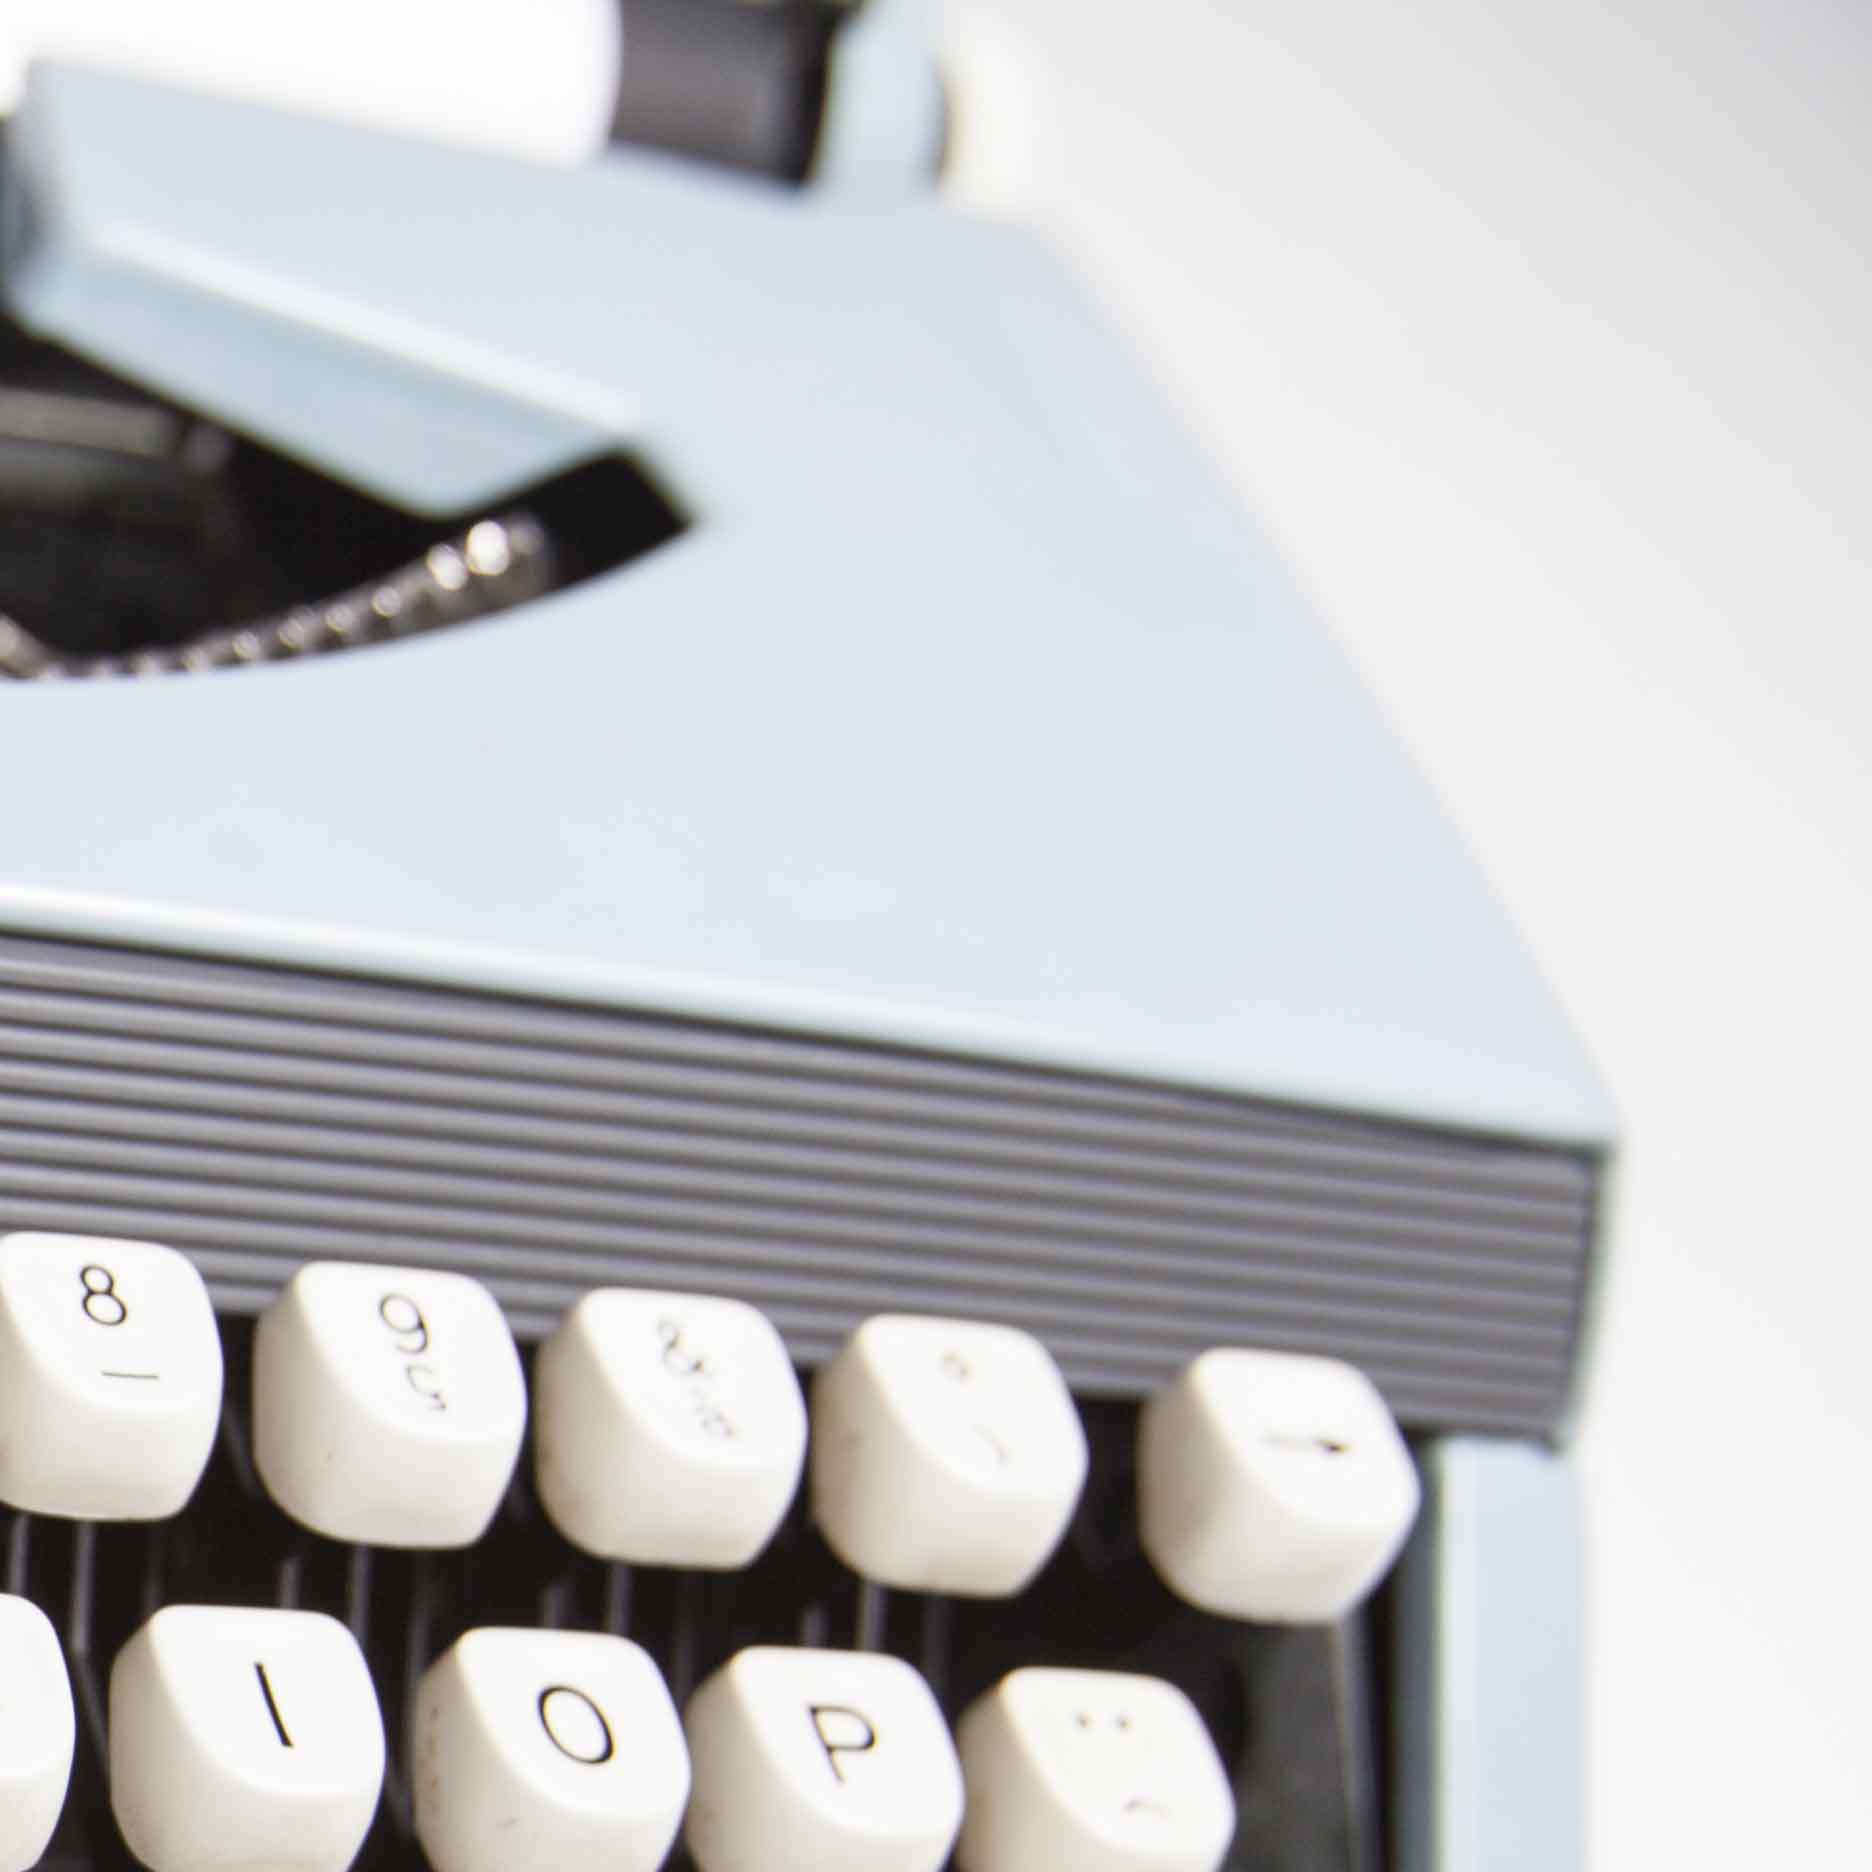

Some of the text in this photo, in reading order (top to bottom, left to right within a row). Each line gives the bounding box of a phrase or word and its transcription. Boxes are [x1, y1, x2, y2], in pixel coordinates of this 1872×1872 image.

[78, 1263, 129, 1327] 8
[377, 1292, 430, 1356] 9
[254, 1663, 293, 1747] I
[537, 1685, 614, 1765] O
[808, 1705, 876, 1781] P
